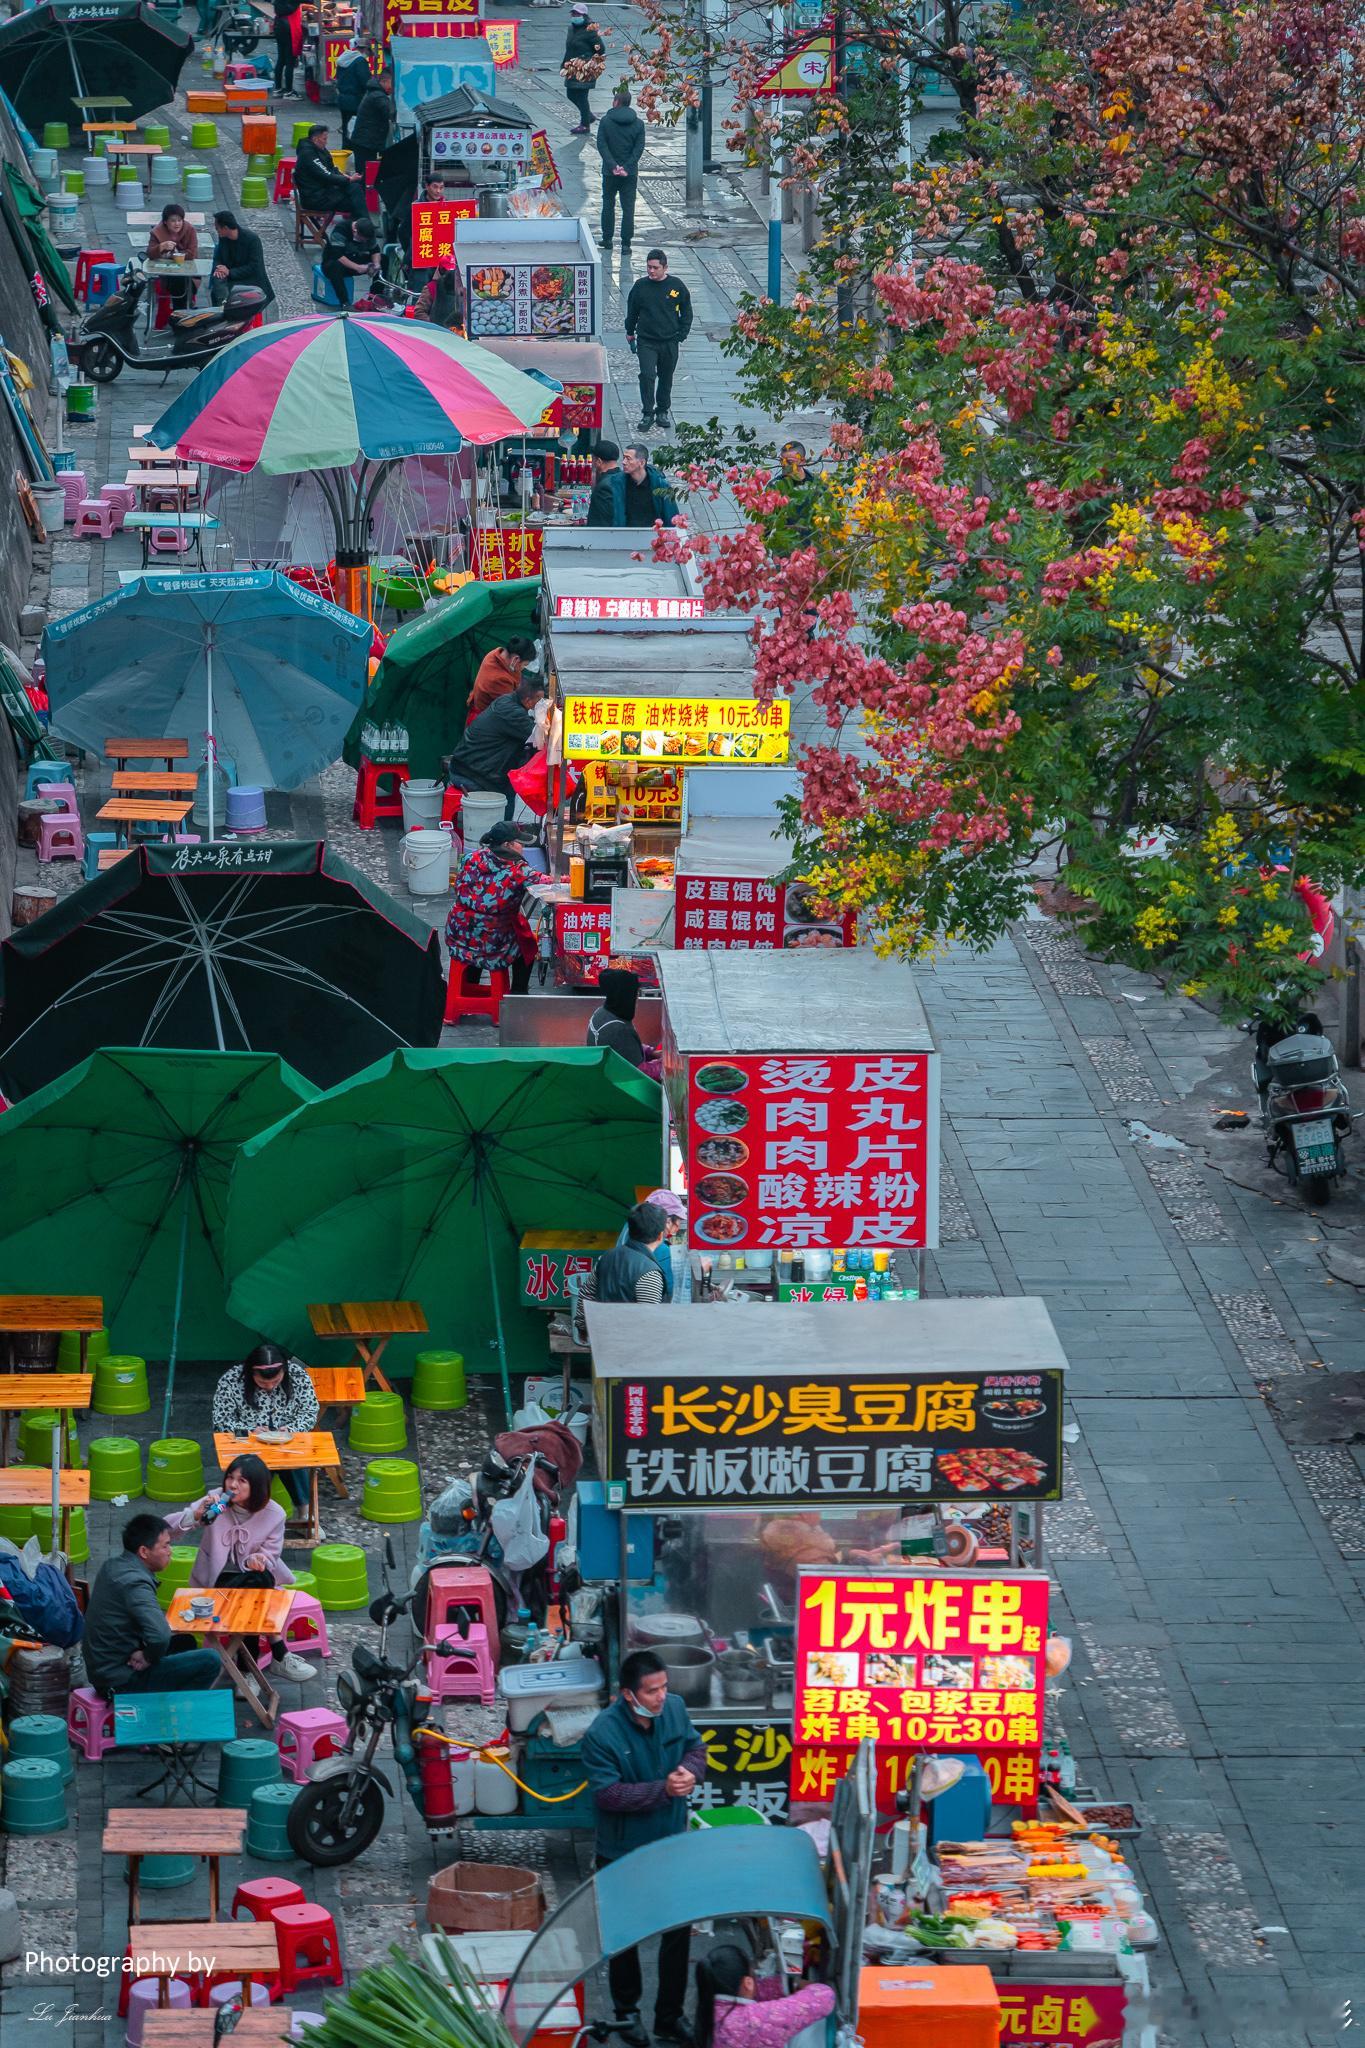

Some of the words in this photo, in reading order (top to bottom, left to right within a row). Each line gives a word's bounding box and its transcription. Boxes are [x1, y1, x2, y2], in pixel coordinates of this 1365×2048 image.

[802, 61, 824, 75] 宋
[419, 211, 433, 259] 豆腐花
[438, 210, 451, 257] 豆浆
[518, 270, 528, 296] 关东煮
[578, 269, 588, 296] 酸辣粉
[518, 301, 528, 332] 宁都肉丸
[480, 532, 543, 552] 手抓
[481, 556, 543, 576] 烤冷
[560, 599, 600, 617] 酸辣粉
[573, 701, 636, 726] 铁板豆腐
[646, 703, 709, 728] 油炸烧烤
[719, 705, 783, 729] 10元30串
[171, 845, 273, 870] 农夫山泉有点甜
[685, 880, 777, 903] 皮蛋馄饨
[563, 911, 611, 930] 油炸串
[684, 909, 775, 932] 咸蛋馄饨
[758, 1058, 922, 1094] 烫皮
[765, 1097, 922, 1132] 肉丸
[765, 1135, 918, 1170] 肉片
[758, 1172, 920, 1209] 酸辣粉
[757, 1212, 920, 1247] 凉皮
[651, 1380, 979, 1436] 长沙臭豆腐
[626, 1445, 934, 1496] 铁板嫩豆腐
